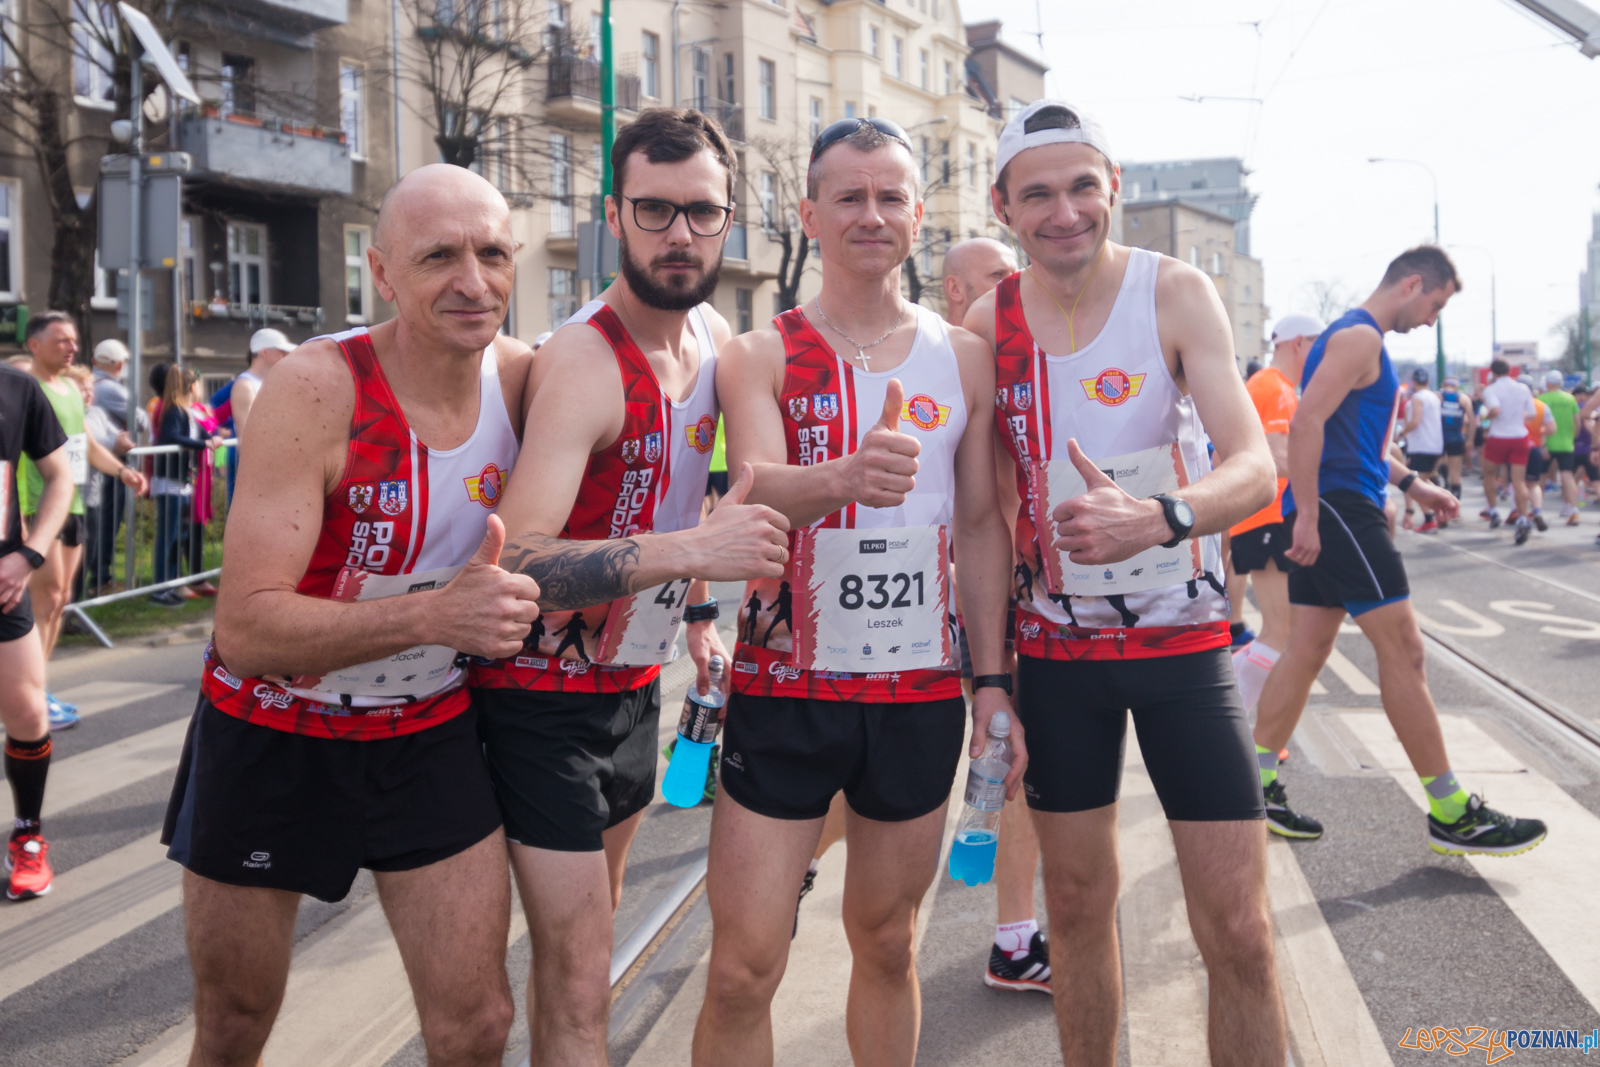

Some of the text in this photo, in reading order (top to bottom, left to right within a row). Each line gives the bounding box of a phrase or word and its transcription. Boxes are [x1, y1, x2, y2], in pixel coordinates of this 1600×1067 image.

[871, 542, 885, 550] PKO
[1130, 567, 1144, 577] 4F
[838, 571, 925, 611] 8321
[867, 617, 904, 630] Leszek
[888, 645, 902, 654] 4F
[391, 650, 427, 662] Jacek
